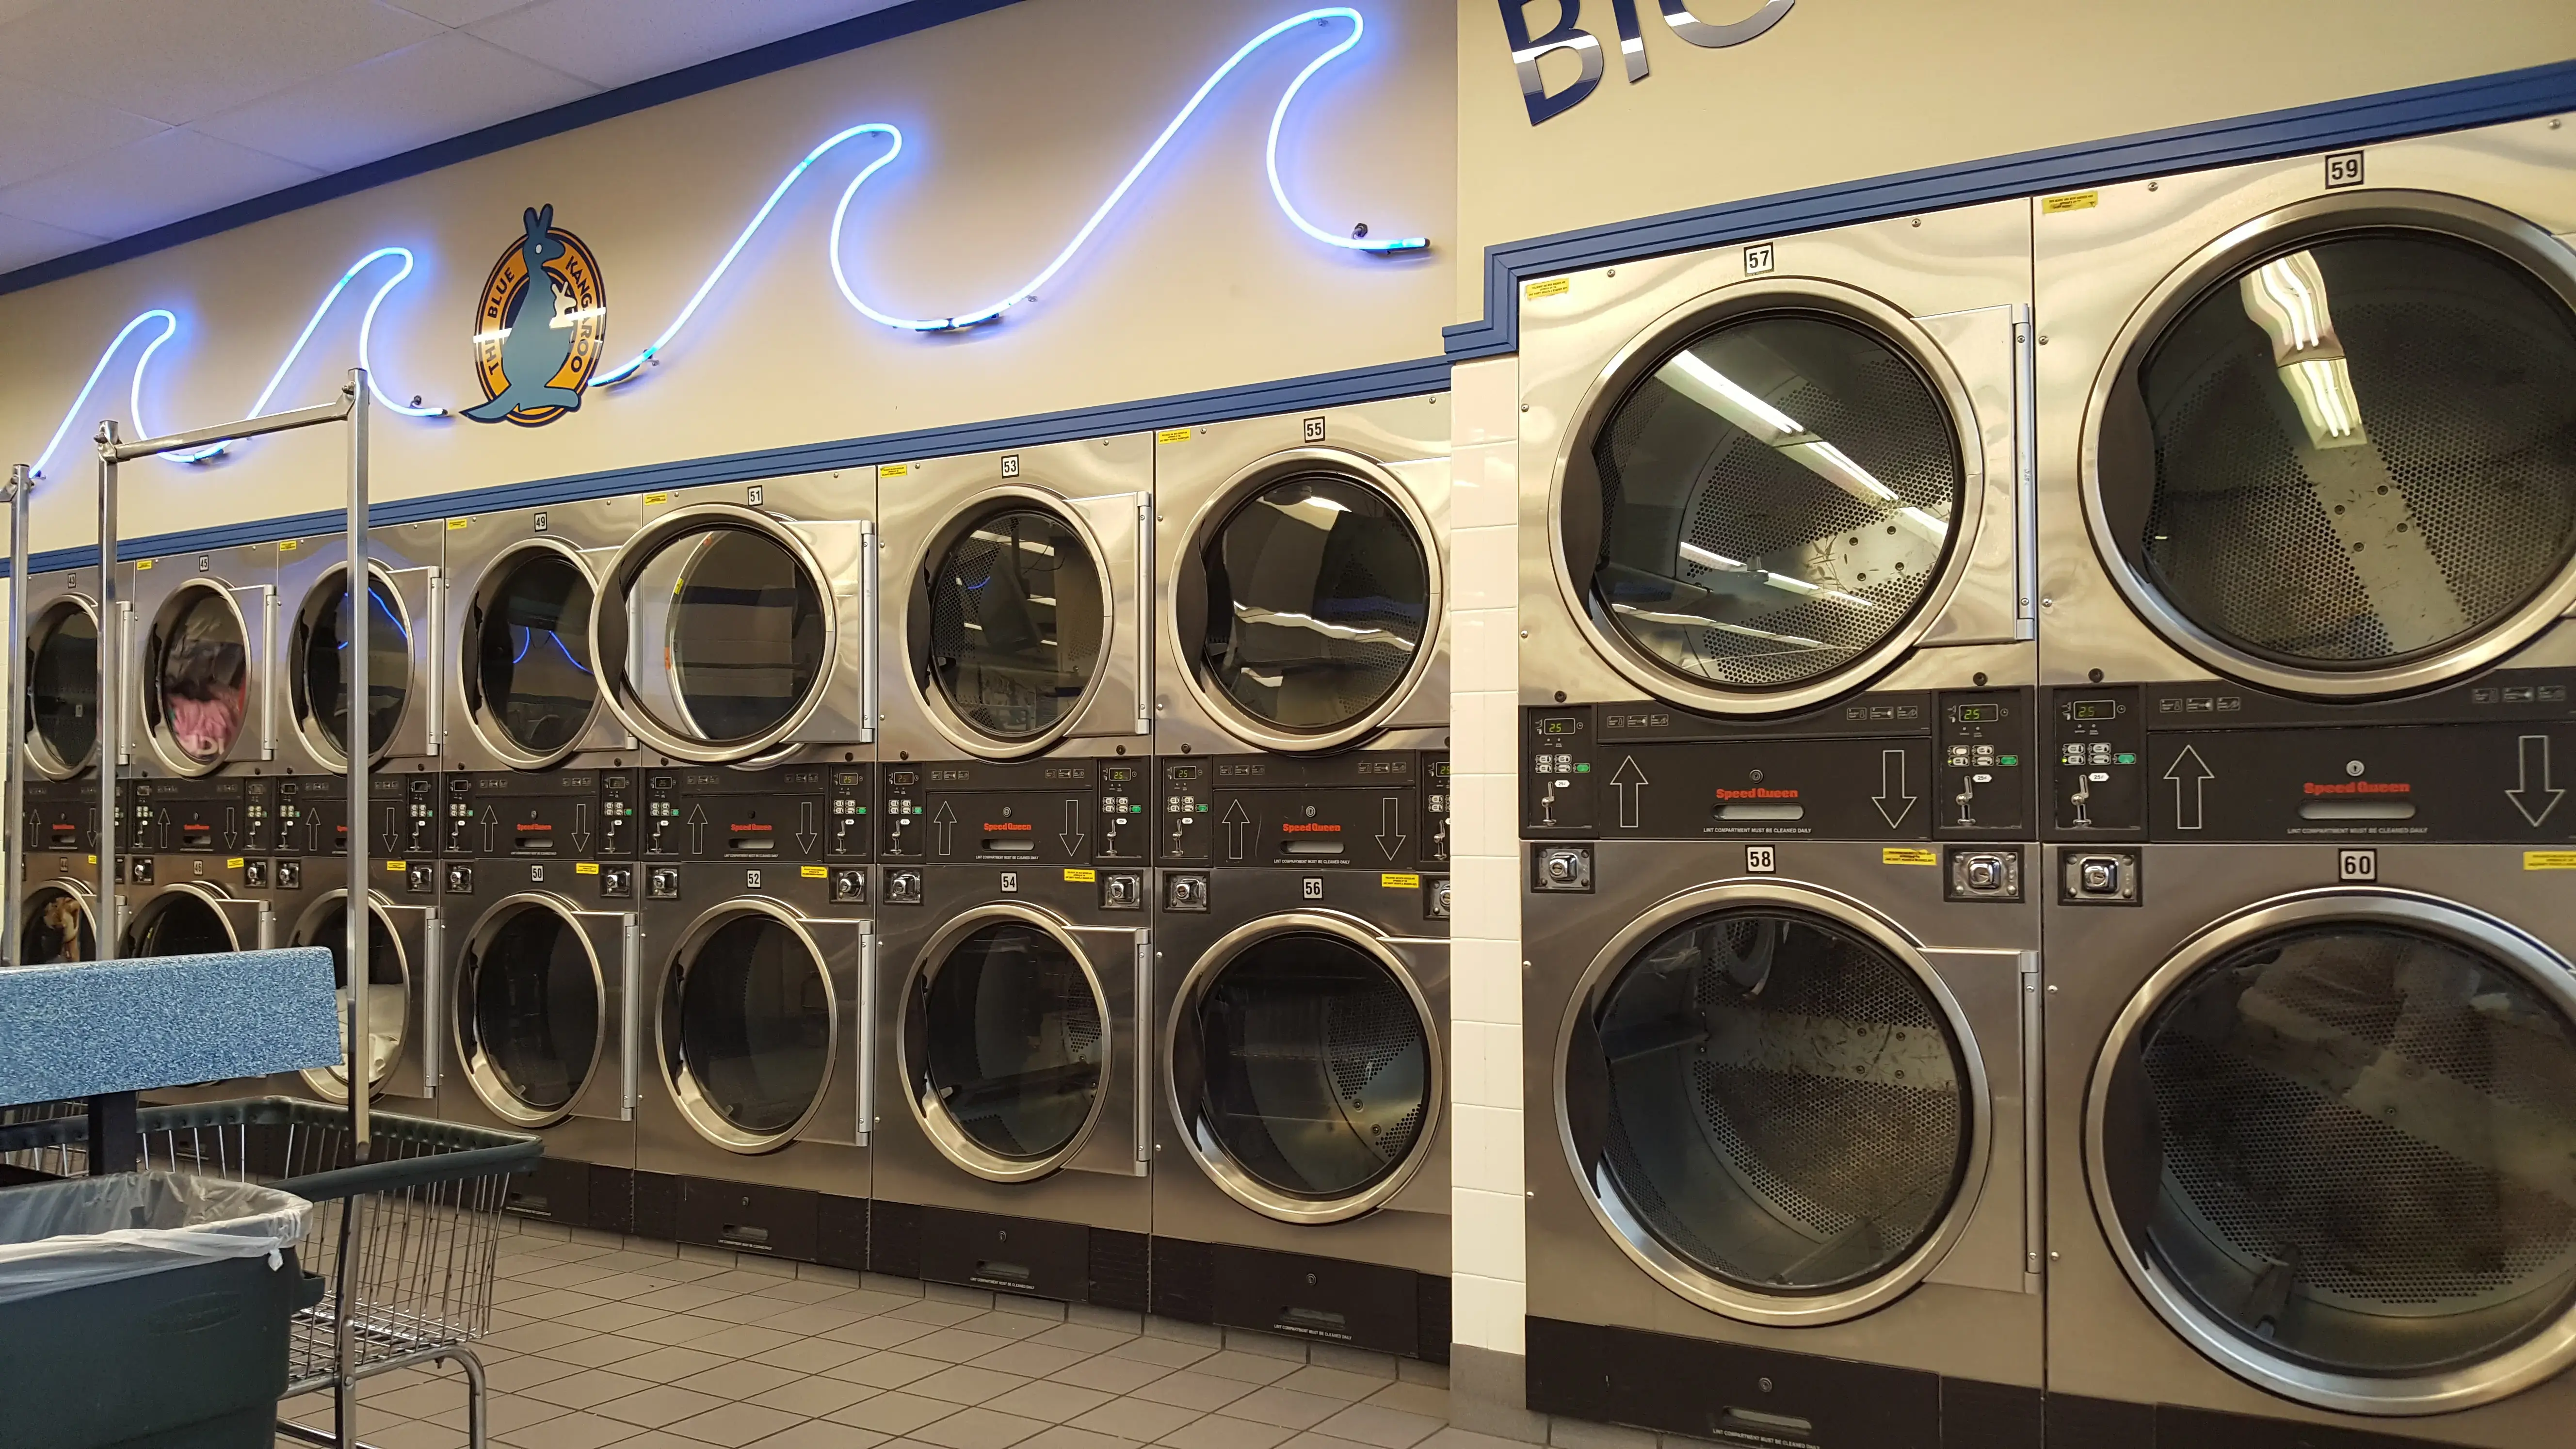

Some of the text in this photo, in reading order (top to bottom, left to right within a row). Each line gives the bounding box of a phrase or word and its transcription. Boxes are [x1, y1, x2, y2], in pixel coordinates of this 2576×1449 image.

[2332, 159, 2358, 180] 59
[1750, 250, 1769, 268] 57
[487, 267, 515, 319] BLUE
[1307, 422, 1321, 436] 55
[1004, 460, 1016, 473] 53
[750, 491, 759, 502] 51
[536, 516, 545, 527] 49
[200, 559, 208, 568] 45
[1964, 709, 1980, 719] 25
[2078, 707, 2095, 717] 25
[1549, 723, 1562, 732] 25
[2304, 781, 2410, 795] Speed Queen
[1716, 788, 1798, 800] Speed Queen
[984, 823, 1007, 831] Speed
[1283, 823, 1341, 833] Speed Queen
[1751, 851, 1771, 867] 58
[195, 863, 202, 872] 46
[2345, 856, 2371, 874] 60
[533, 868, 542, 878] 50
[749, 873, 759, 884] 52
[1003, 876, 1015, 887] 54
[1306, 882, 1320, 895] 56
